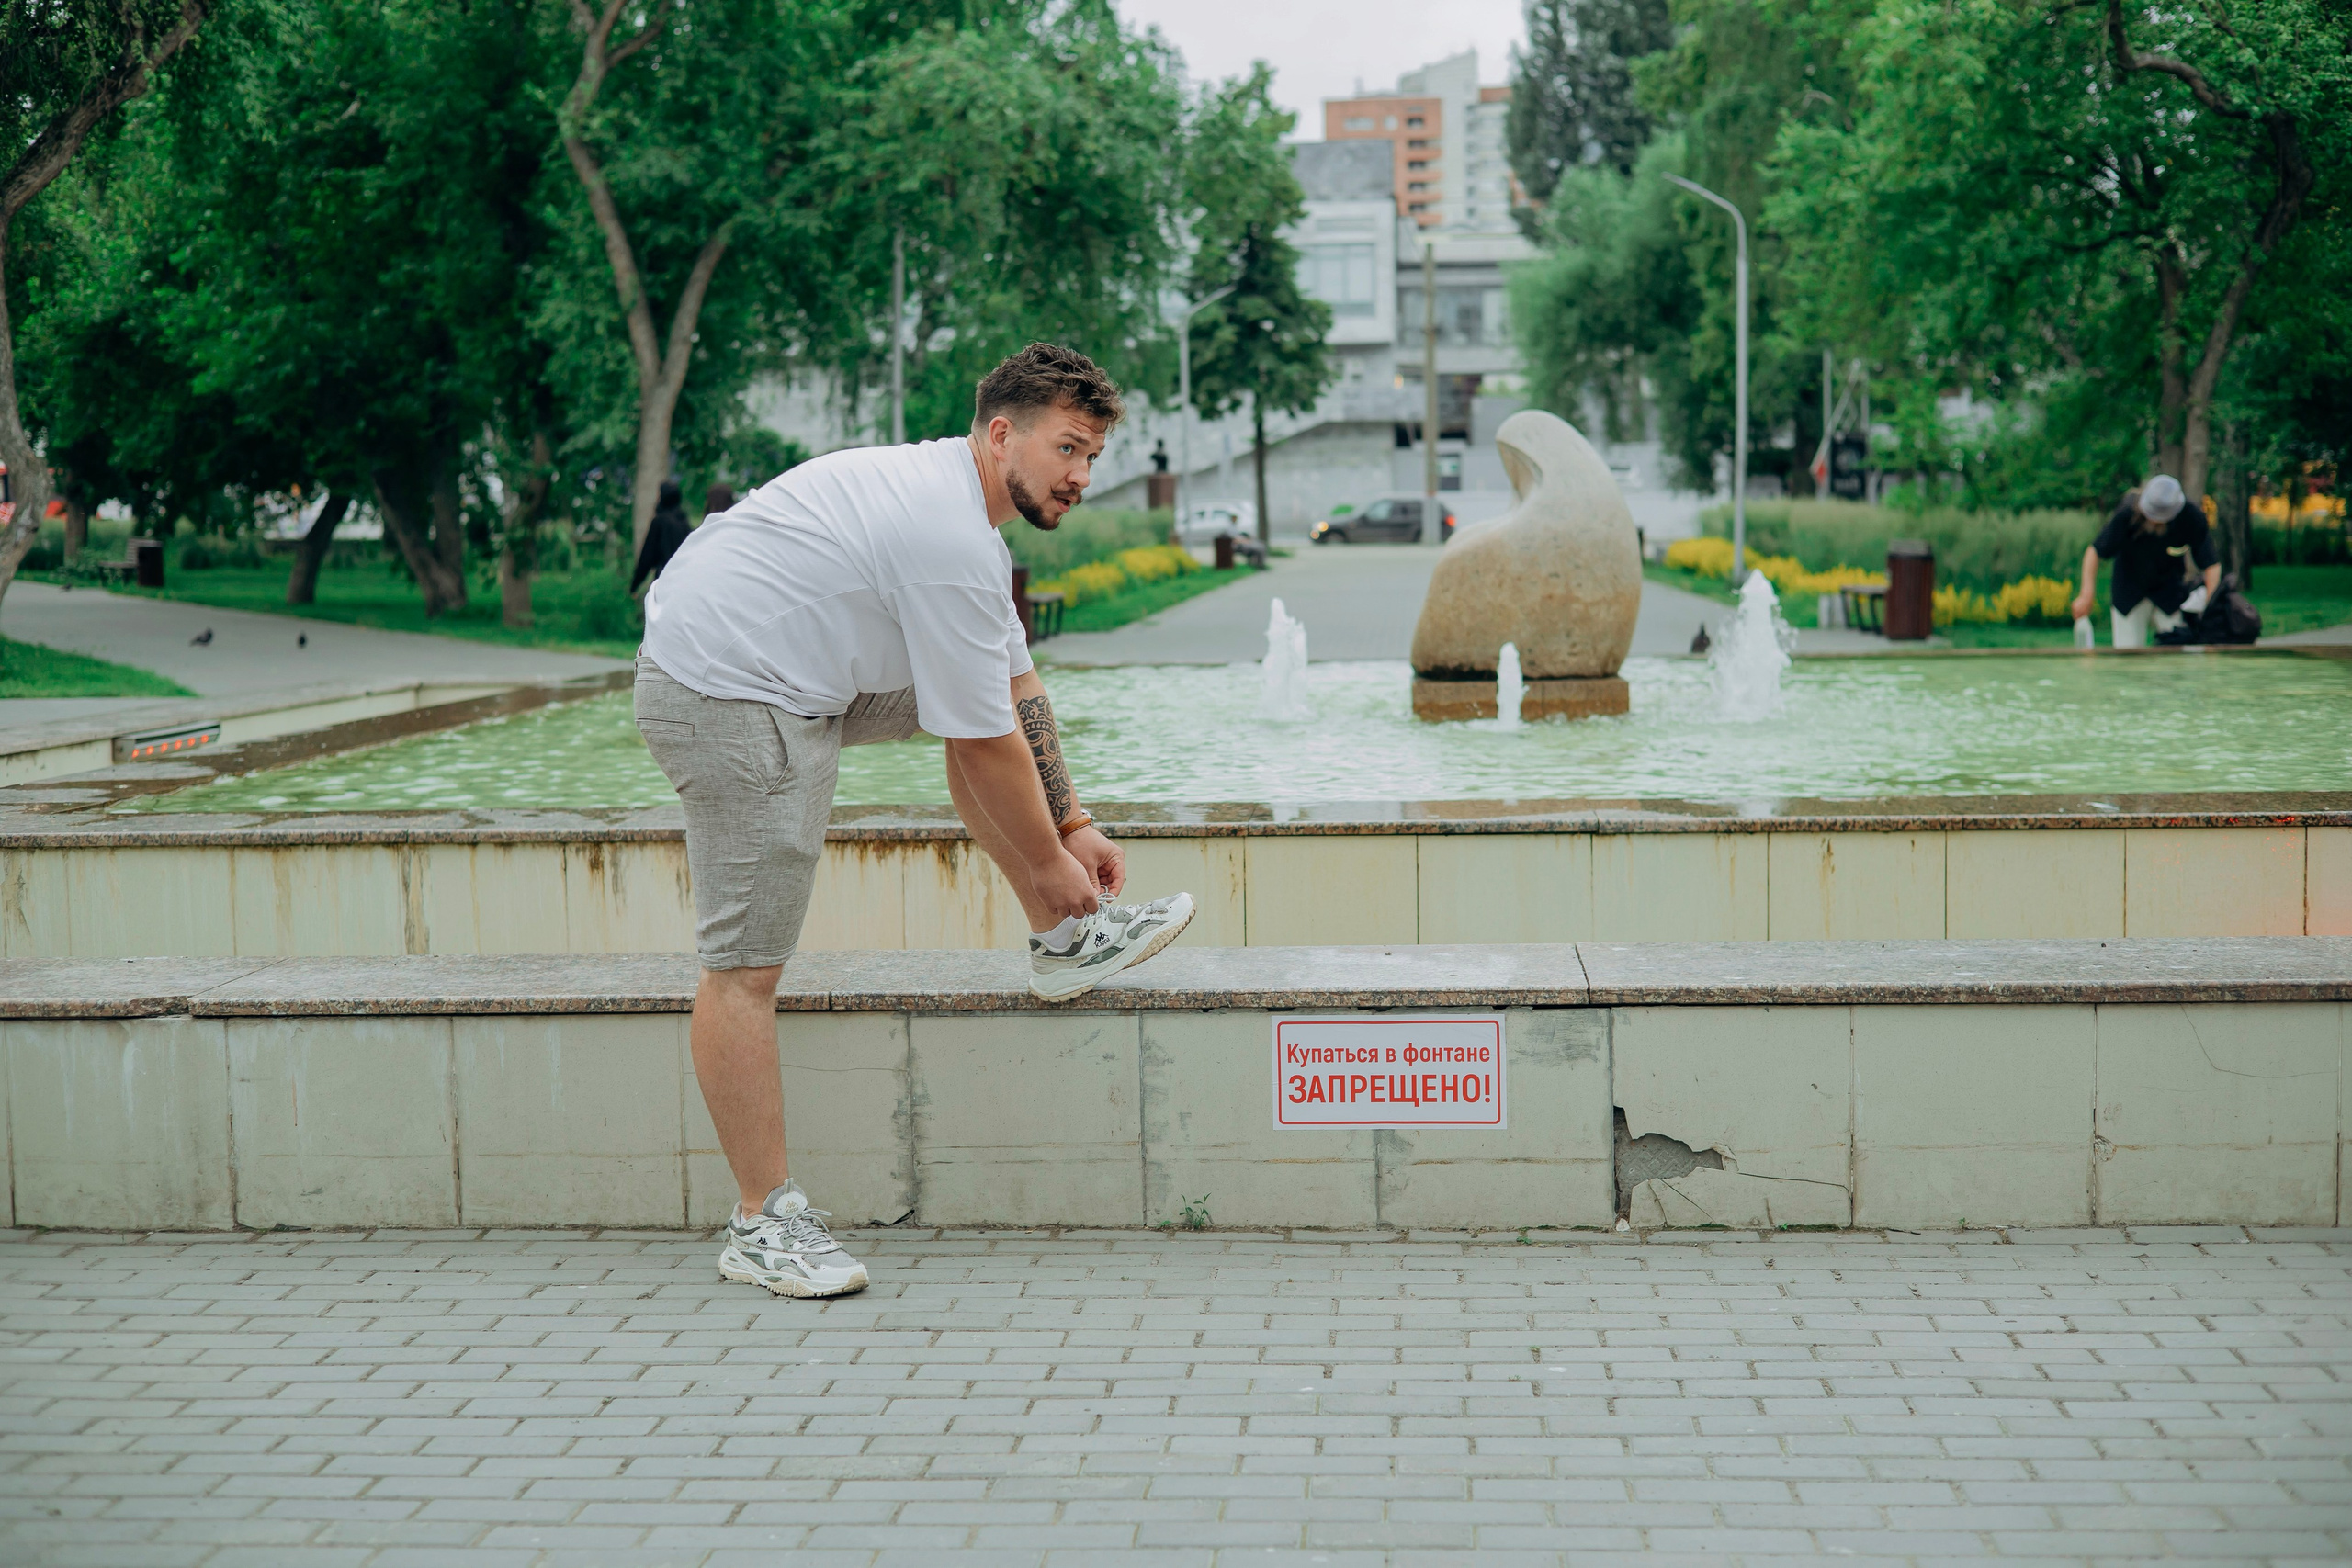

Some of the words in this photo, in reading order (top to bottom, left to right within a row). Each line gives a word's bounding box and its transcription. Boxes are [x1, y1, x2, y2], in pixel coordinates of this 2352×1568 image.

[1287, 1043, 1378, 1067] Купаться
[1385, 1047, 1396, 1063] в
[1403, 1043, 1490, 1066] фонтане
[1288, 1074, 1490, 1107] ЗАПРЕЩЕНО!
